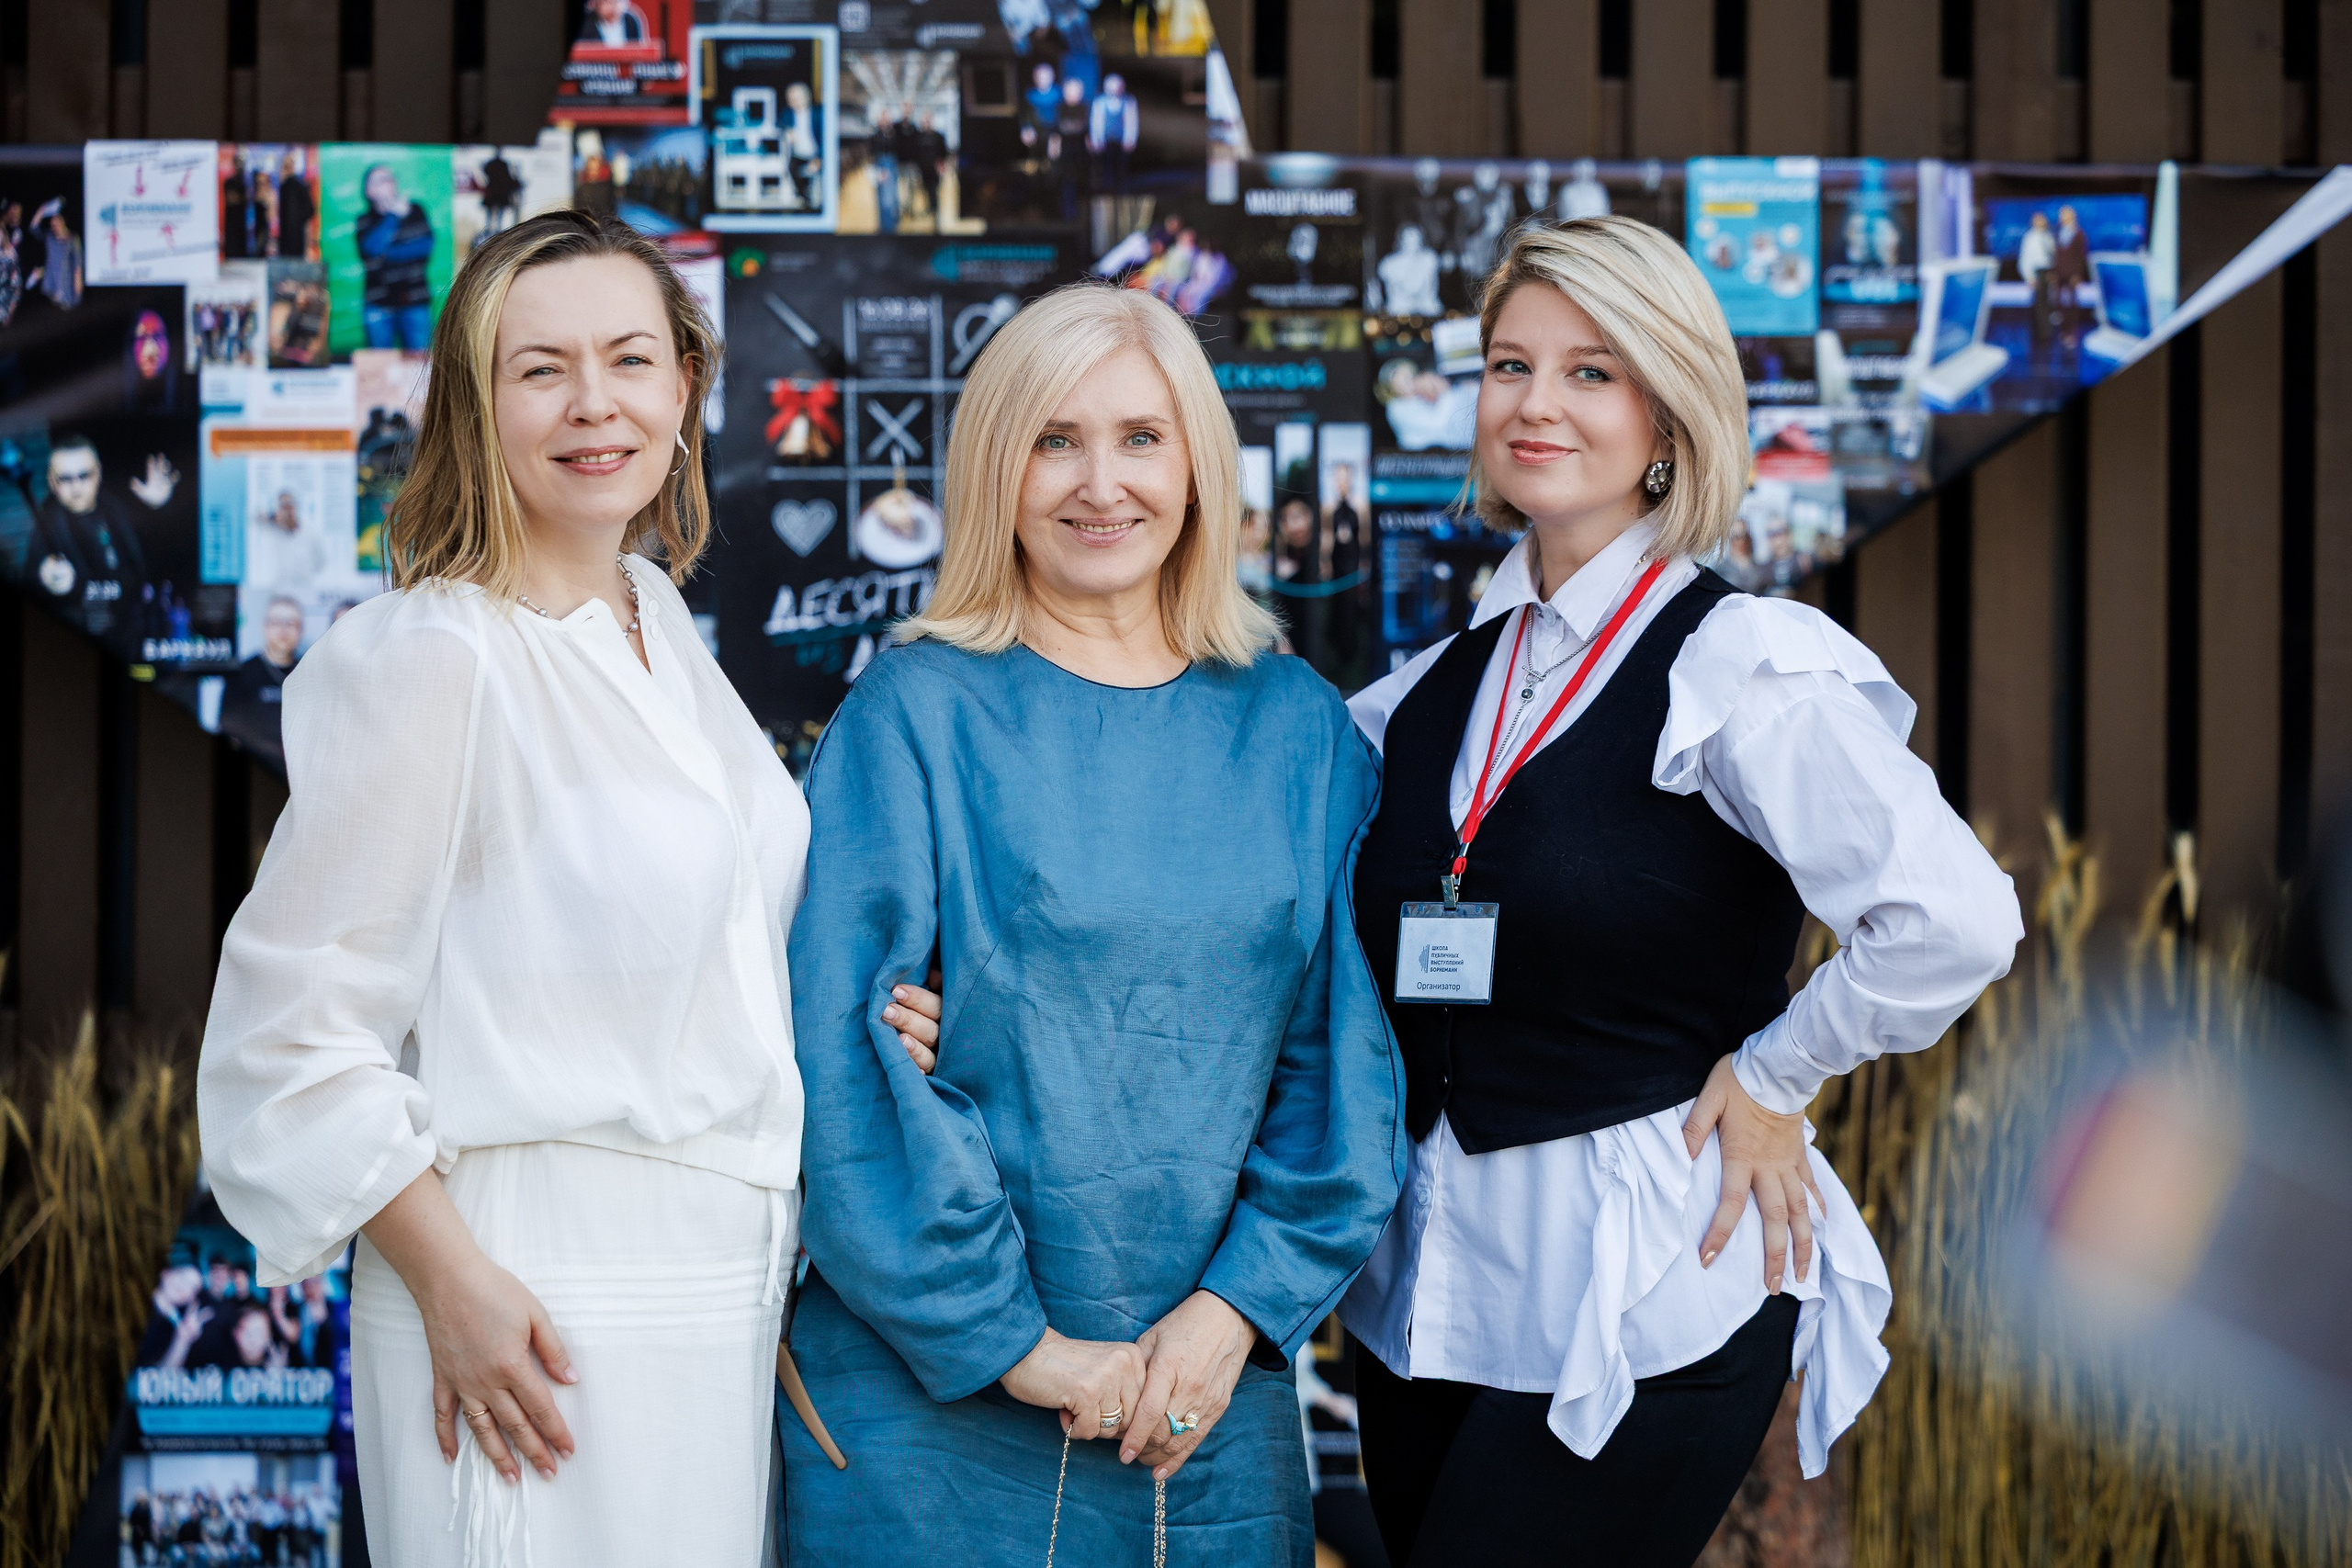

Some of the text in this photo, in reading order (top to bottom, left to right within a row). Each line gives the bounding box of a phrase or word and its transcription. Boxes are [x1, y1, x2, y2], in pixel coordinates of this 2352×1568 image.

[1210, 357, 1327, 391] СКНОЙ
[1416, 981, 1461, 992] Организатор
[137, 1363, 335, 1404] ЮНЫЙ ОРАТОР
